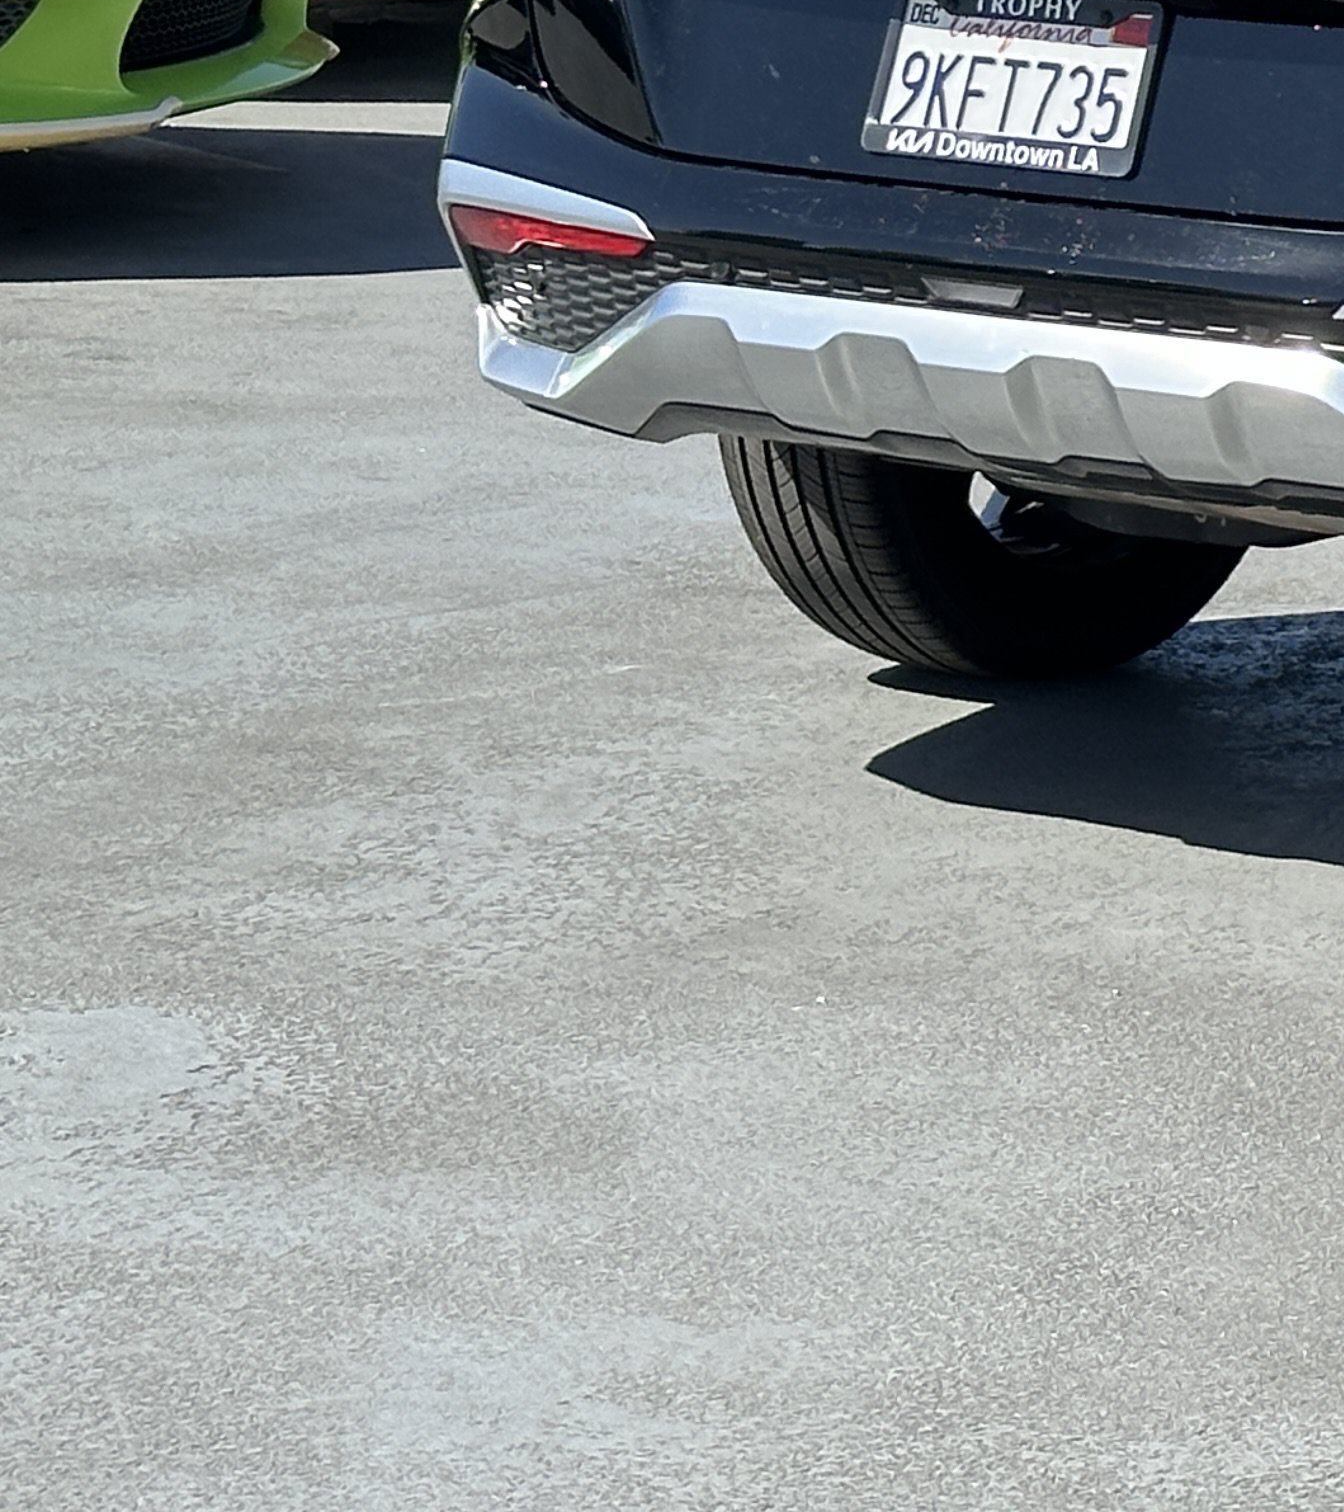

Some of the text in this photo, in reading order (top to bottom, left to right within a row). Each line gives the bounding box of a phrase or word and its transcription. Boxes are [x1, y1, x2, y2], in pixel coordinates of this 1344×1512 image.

[910, 2, 940, 25] DEC
[890, 50, 1129, 142] 9KFT735
[885, 127, 1099, 172] KIA Downtown LA
